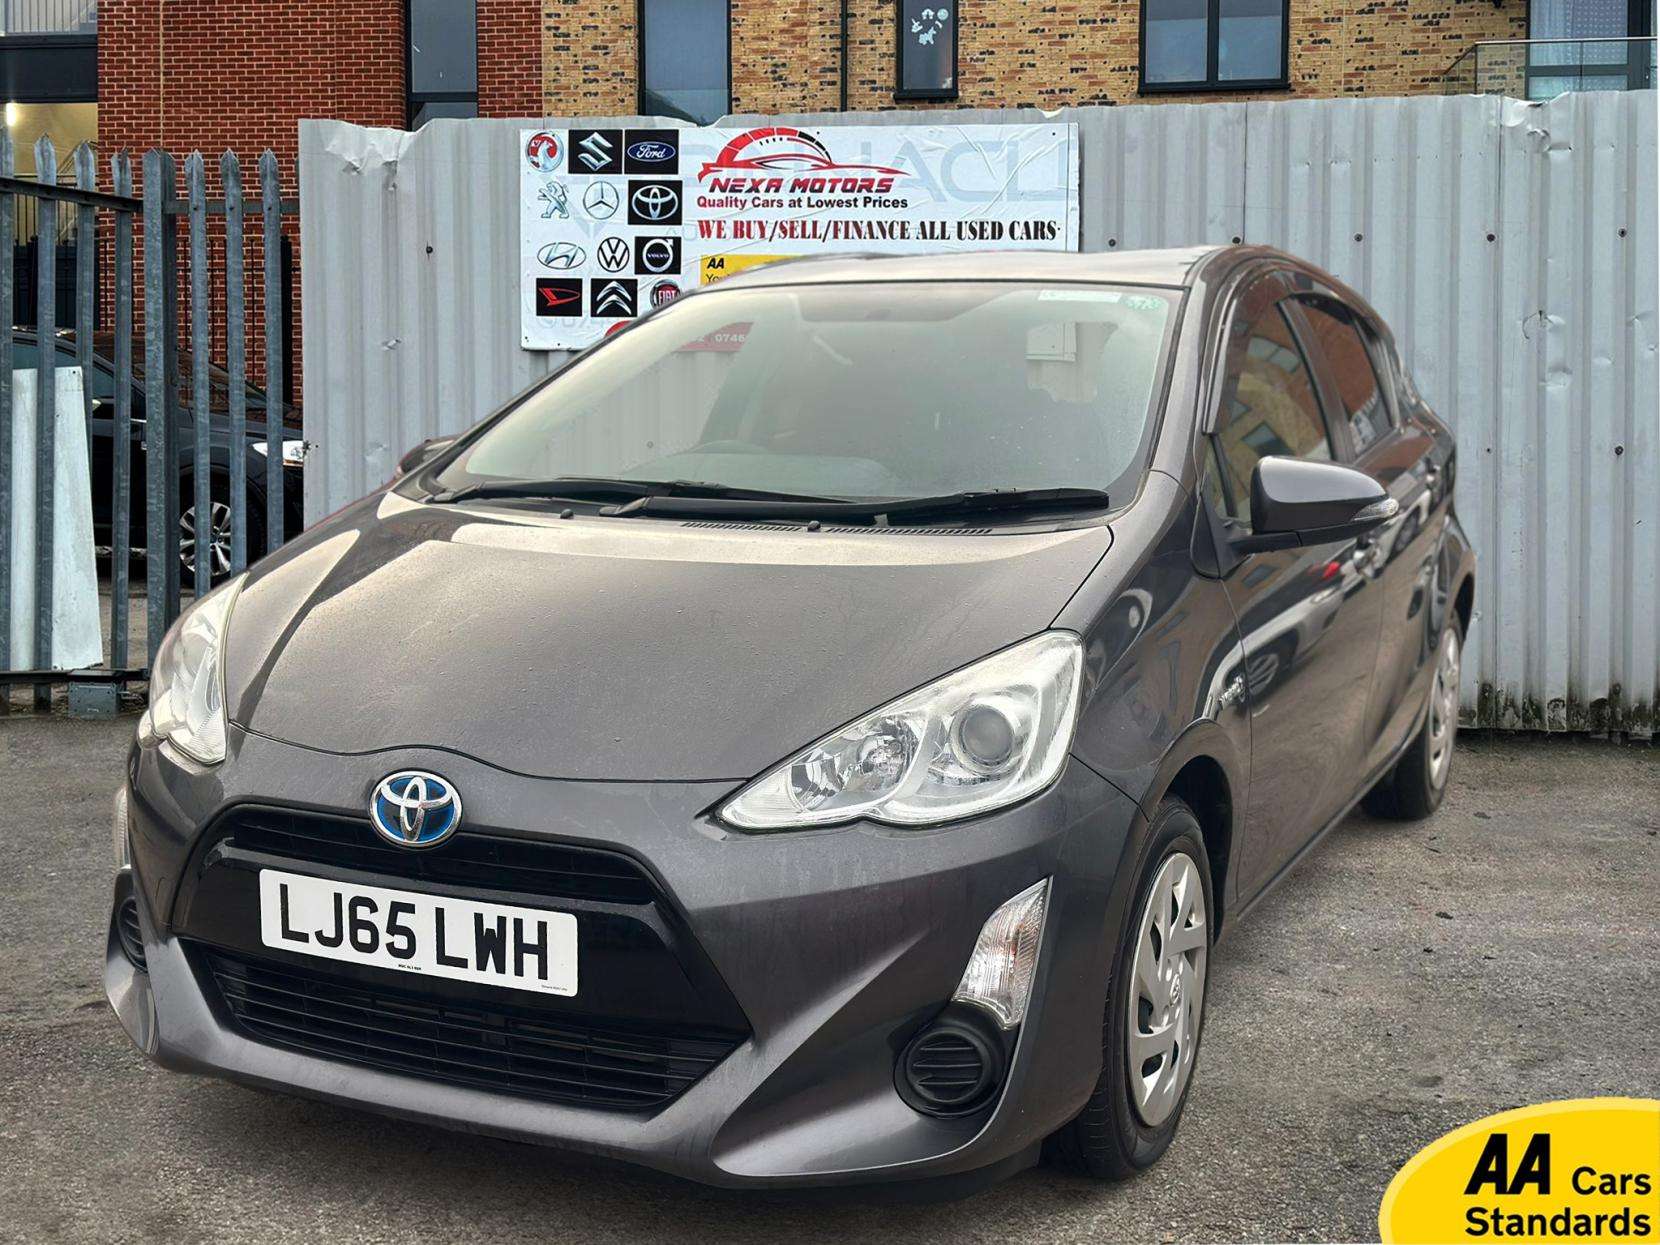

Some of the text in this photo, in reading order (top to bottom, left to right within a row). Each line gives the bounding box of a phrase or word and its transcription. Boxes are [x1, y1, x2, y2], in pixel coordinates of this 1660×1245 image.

[636, 144, 666, 159] Ford
[709, 177, 895, 193] NEXA MOTORS
[697, 195, 908, 211] Quality Cars at Lowest Prices
[697, 220, 727, 240] WE
[733, 219, 910, 243] BUY/SELL/FINANCE
[916, 220, 951, 241] ALL
[956, 220, 1004, 241] USED
[1008, 220, 1057, 241] CARS
[707, 257, 725, 270] AA
[280, 883, 548, 981] LJ65 LWH
